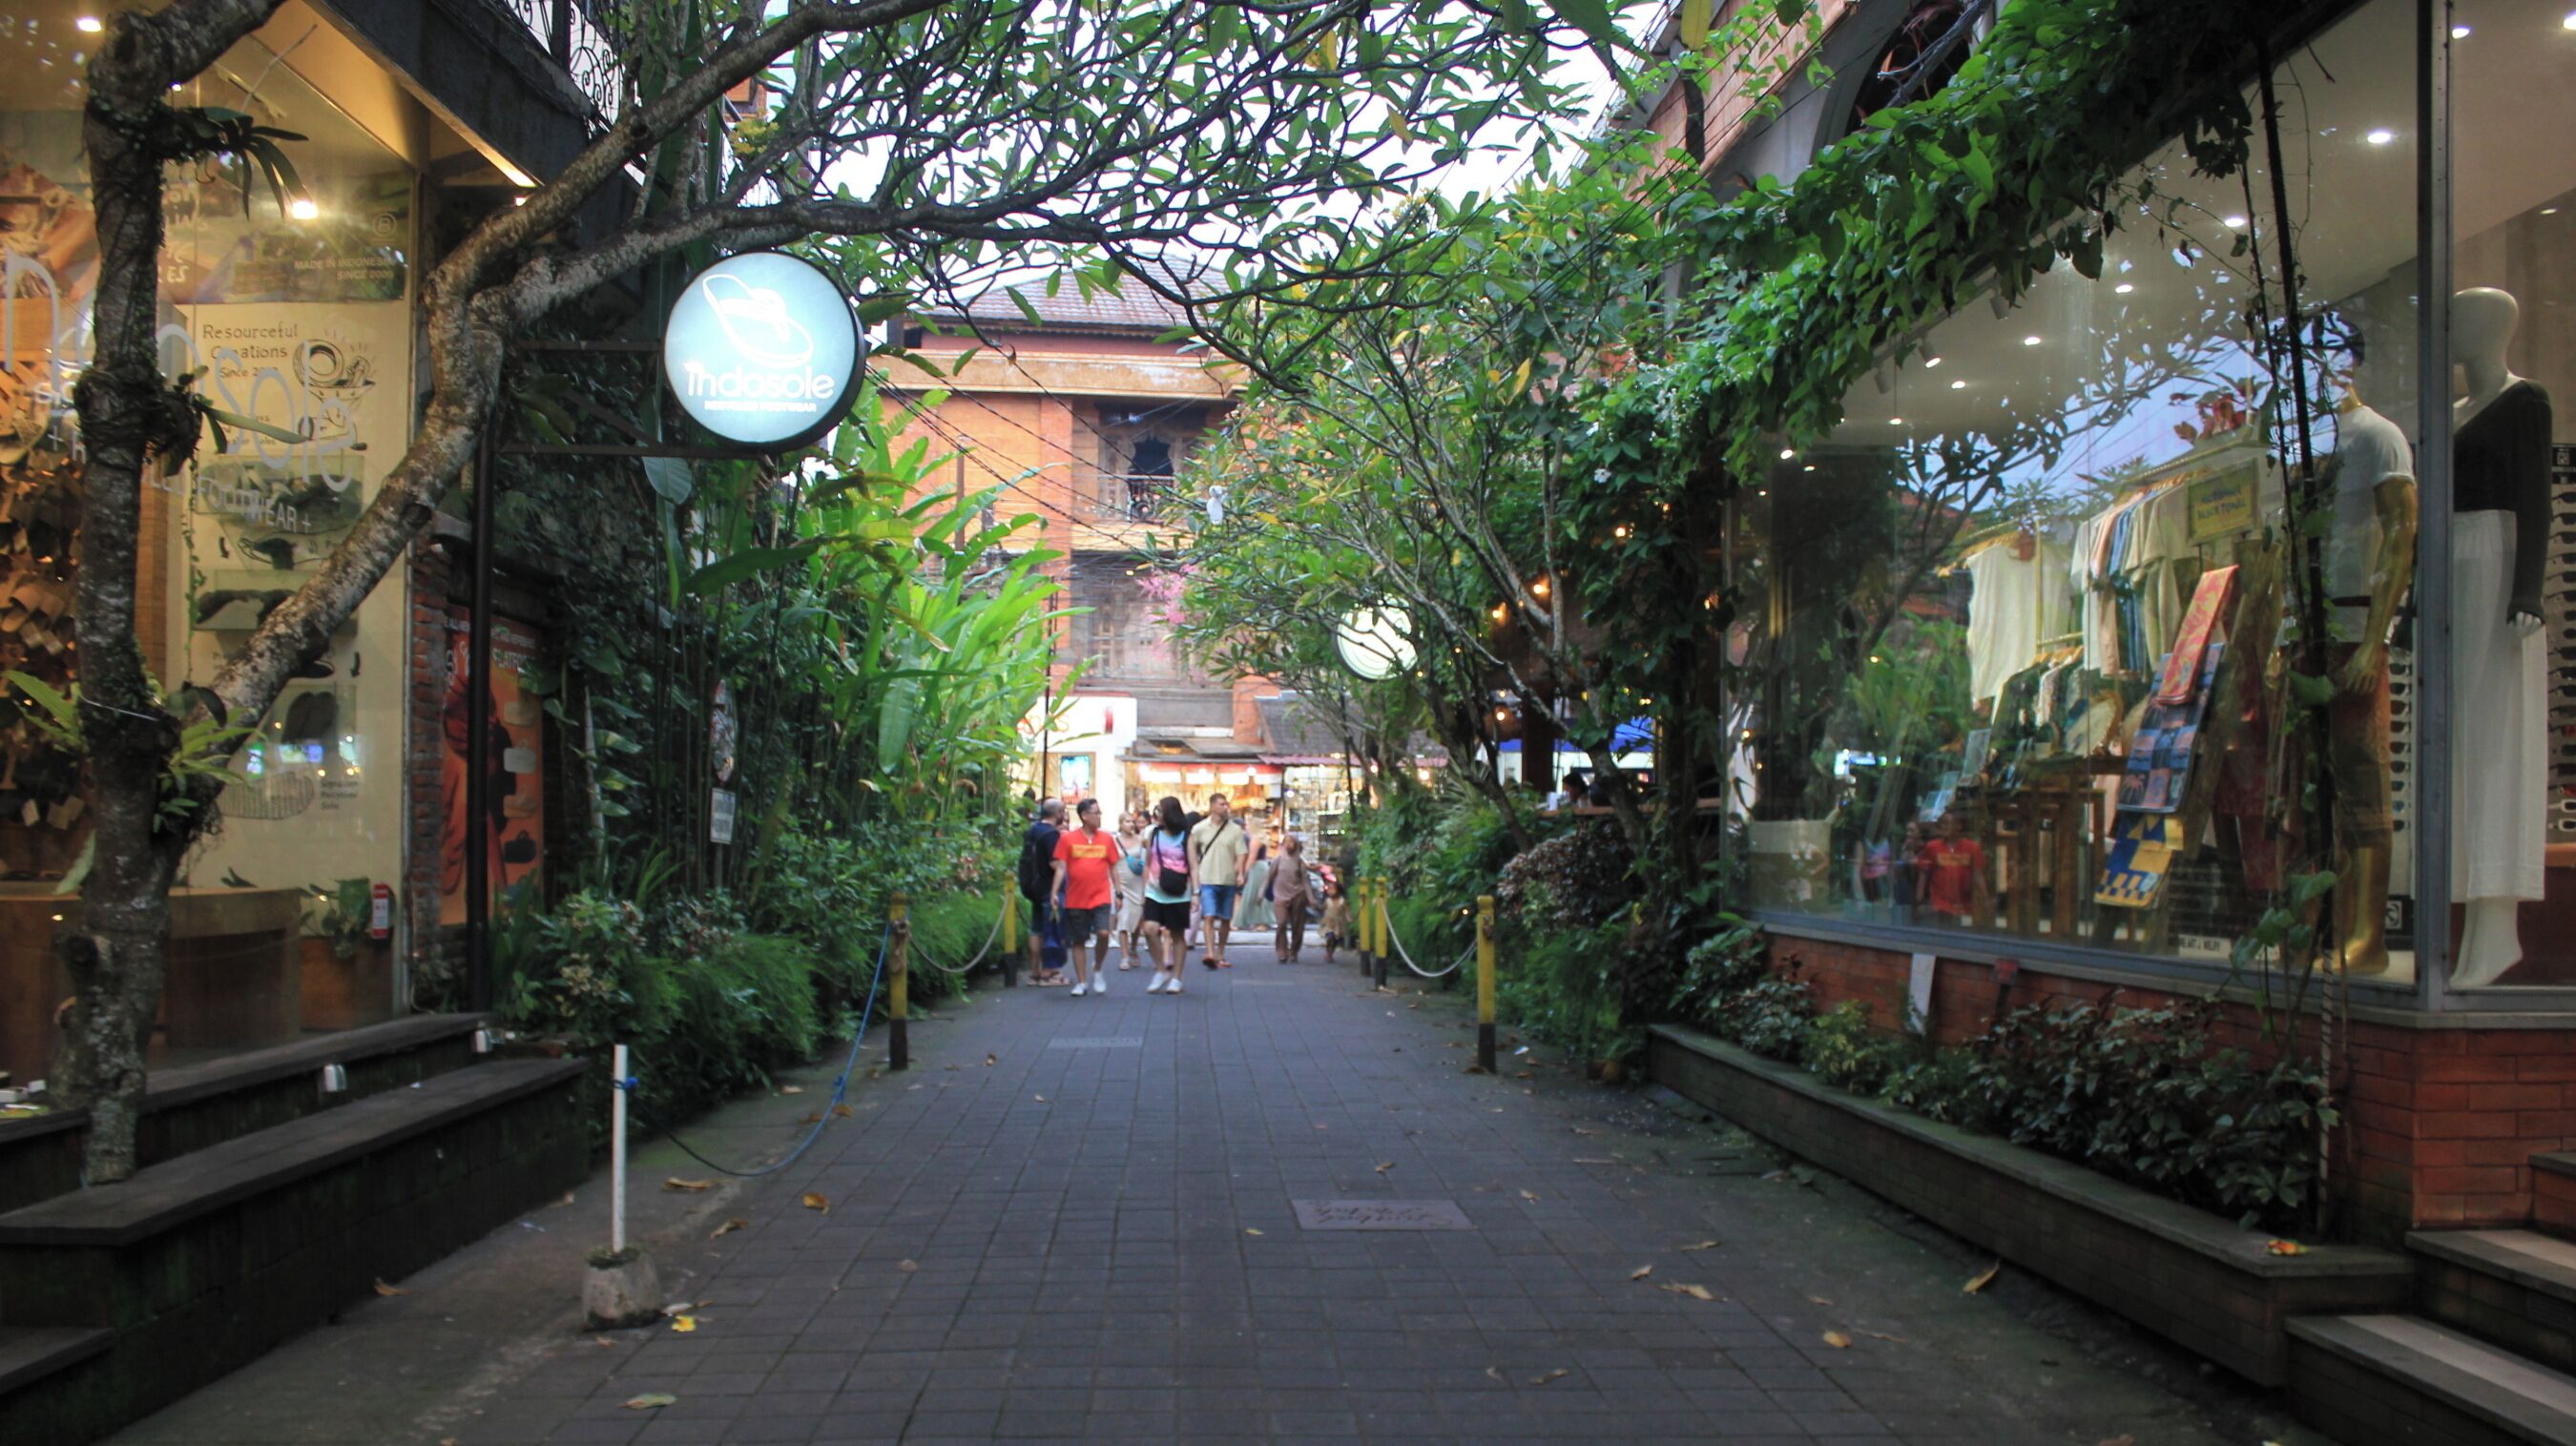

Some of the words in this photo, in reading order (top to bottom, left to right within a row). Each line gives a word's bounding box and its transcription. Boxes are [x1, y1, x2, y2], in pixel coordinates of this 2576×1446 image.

[294, 259, 324, 270] MADE
[324, 258, 336, 268] IN
[337, 270, 367, 280] SINCE
[201, 321, 299, 339] Resourceful
[210, 344, 288, 360] Cations
[197, 475, 297, 532] FOOTWEAR
